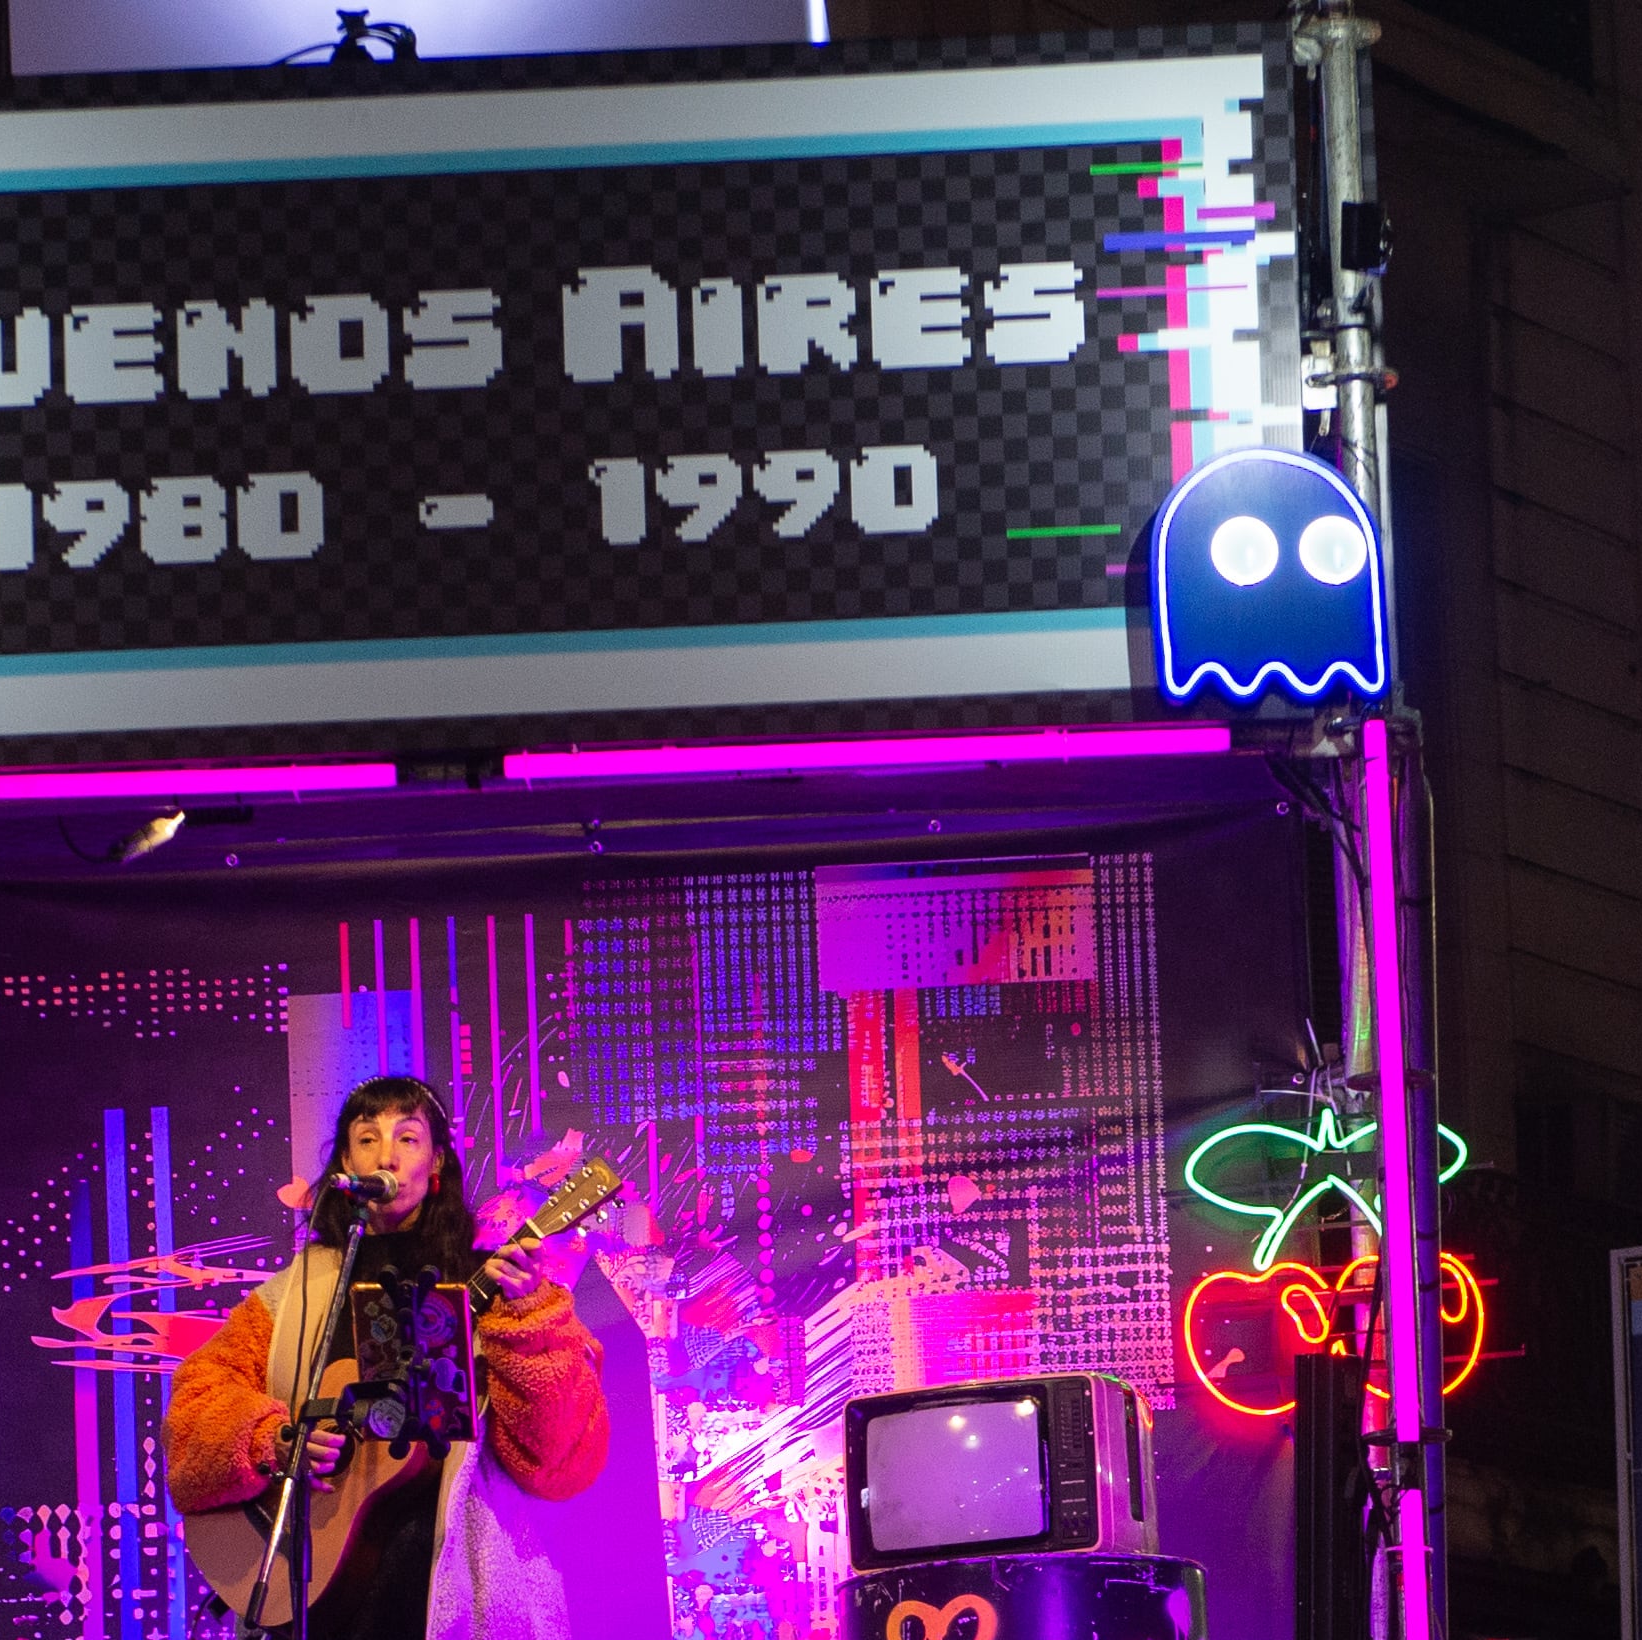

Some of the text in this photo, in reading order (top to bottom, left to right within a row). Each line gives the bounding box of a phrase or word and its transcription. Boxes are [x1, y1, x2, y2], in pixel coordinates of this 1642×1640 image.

[562, 261, 1085, 383] AIRES
[418, 493, 495, 530] -
[588, 444, 938, 545] 1990
